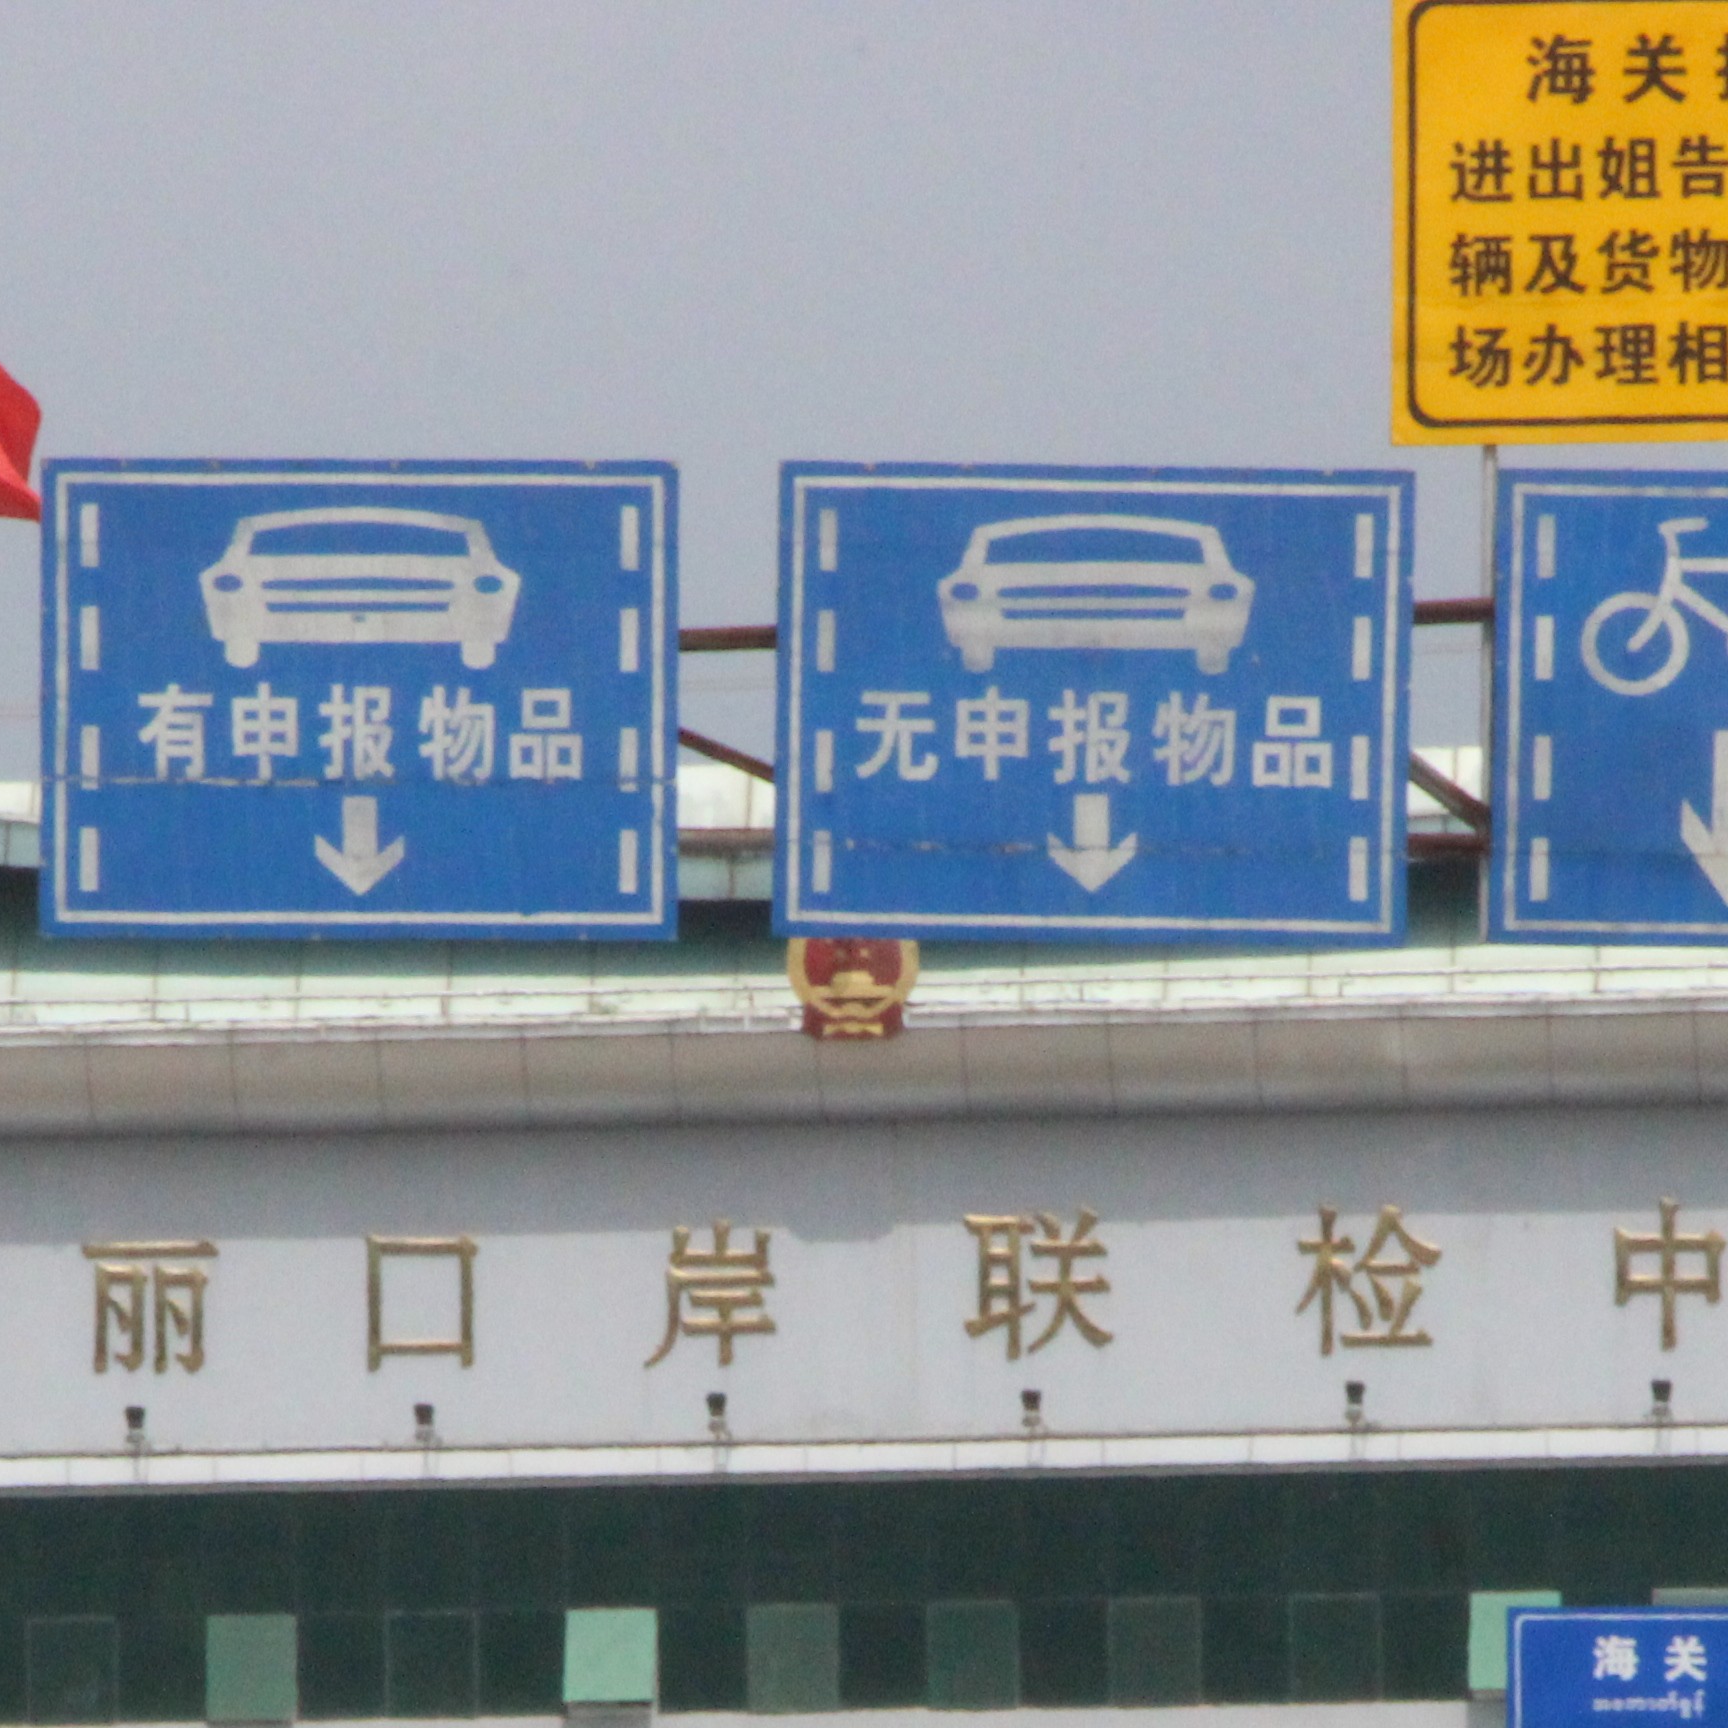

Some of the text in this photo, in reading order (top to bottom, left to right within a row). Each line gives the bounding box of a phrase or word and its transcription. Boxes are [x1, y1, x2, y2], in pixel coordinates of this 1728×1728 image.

[137, 684, 584, 781] 有申报物品
[855, 689, 1335, 790] 无申报物品
[1593, 1635, 1707, 1681] 海关
